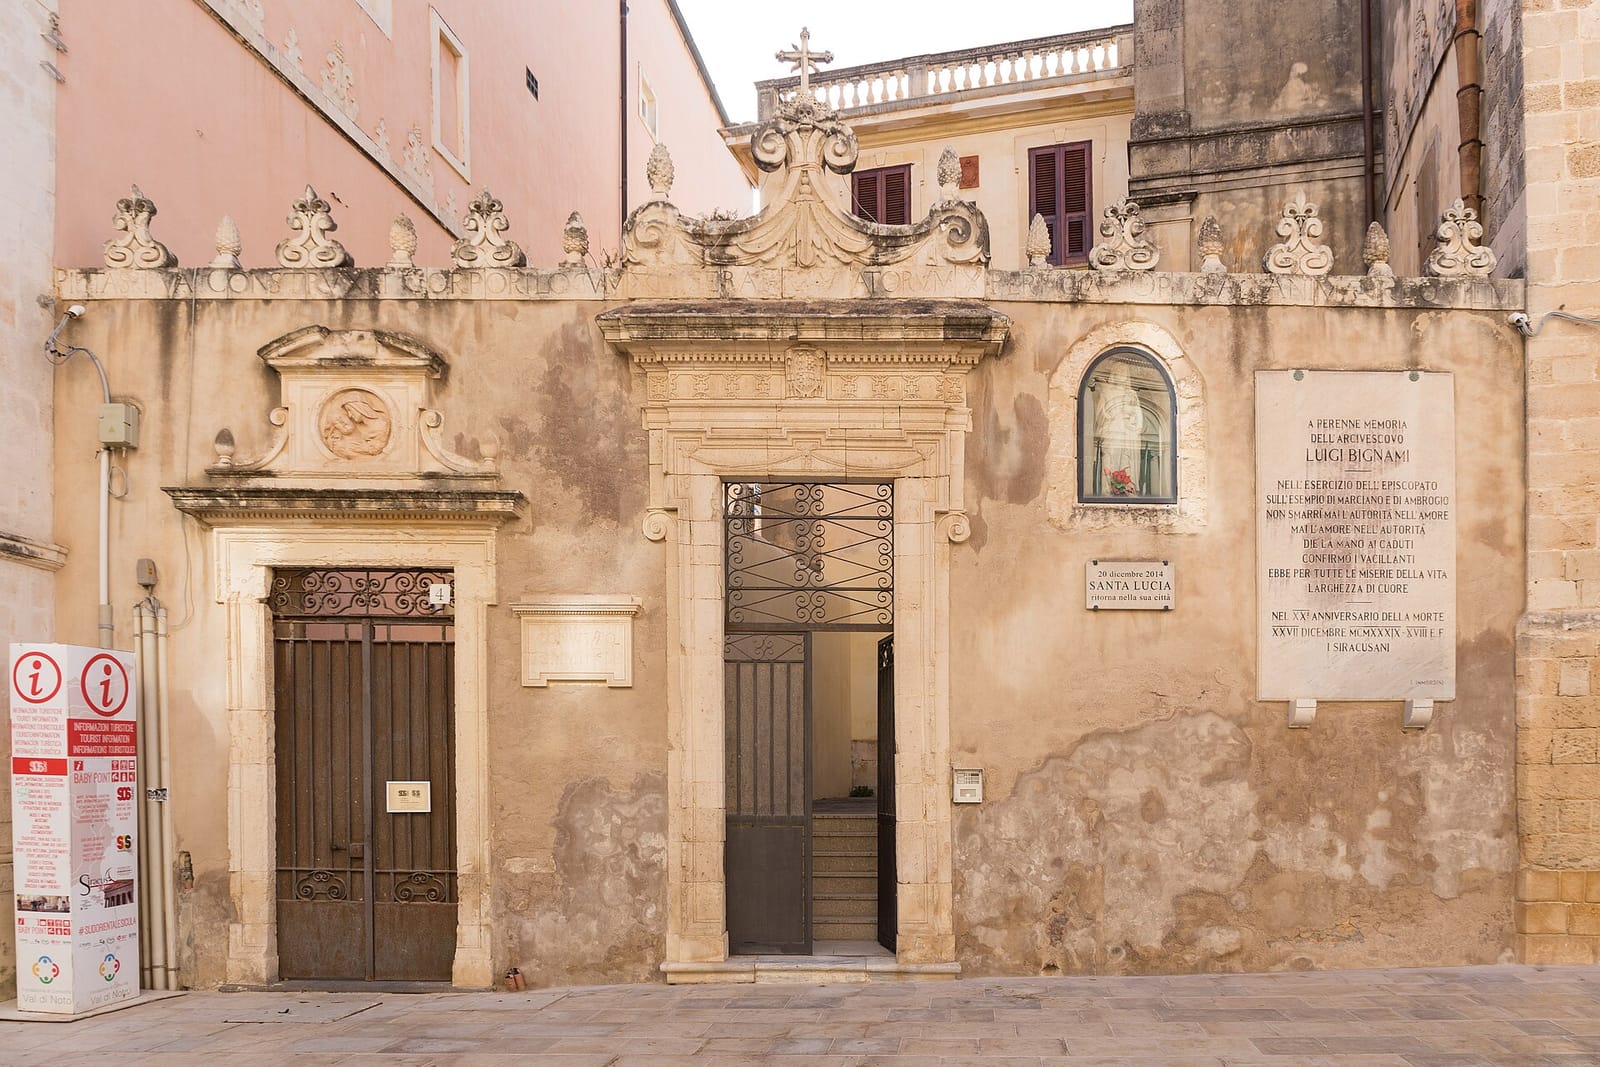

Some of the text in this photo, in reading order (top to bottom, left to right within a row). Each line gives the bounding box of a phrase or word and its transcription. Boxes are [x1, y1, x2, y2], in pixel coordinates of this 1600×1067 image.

[1308, 419, 1407, 429] A PERENNE MEMORIA
[1306, 448, 1409, 462] LUIGI BIGNAMI
[1327, 495, 1336, 505] DI
[1338, 495, 1384, 505] MARCIANO
[1386, 495, 1391, 505] E
[1393, 495, 1402, 505] DI
[1405, 495, 1449, 505] AMBROGIO
[1266, 508, 1286, 520] NON
[1324, 508, 1340, 520] MAI
[1291, 524, 1308, 534] MAI
[1321, 540, 1333, 549] LA
[1337, 540, 1364, 549] MANO
[1368, 540, 1376, 549] AI
[1379, 540, 1414, 549] CADUTI
[1355, 553, 1358, 564] I
[1361, 553, 1415, 564] VACILLANTI
[1269, 569, 1448, 579] EBBE PER TUTTE LE MISERIE DELLA VITA
[1089, 581, 1171, 590] SANTA LUCIA
[1308, 584, 1408, 593] LARGHEZZA DI CUORE
[435, 588, 444, 600] 4
[1091, 593, 1171, 601] ritorna nella sua città
[1272, 611, 1288, 621] NEL
[1312, 611, 1379, 621] ANNIVERSARIO
[1382, 611, 1410, 621] DELLA
[1413, 611, 1445, 621] MORTE
[1301, 627, 1346, 638] DICEMBRE
[1349, 627, 1401, 638] MCMXXXIX
[1333, 643, 1390, 652] SIRACUSANI
[80, 734, 101, 743] TOURIST
[74, 772, 92, 784] BABY
[93, 772, 111, 784] POINT
